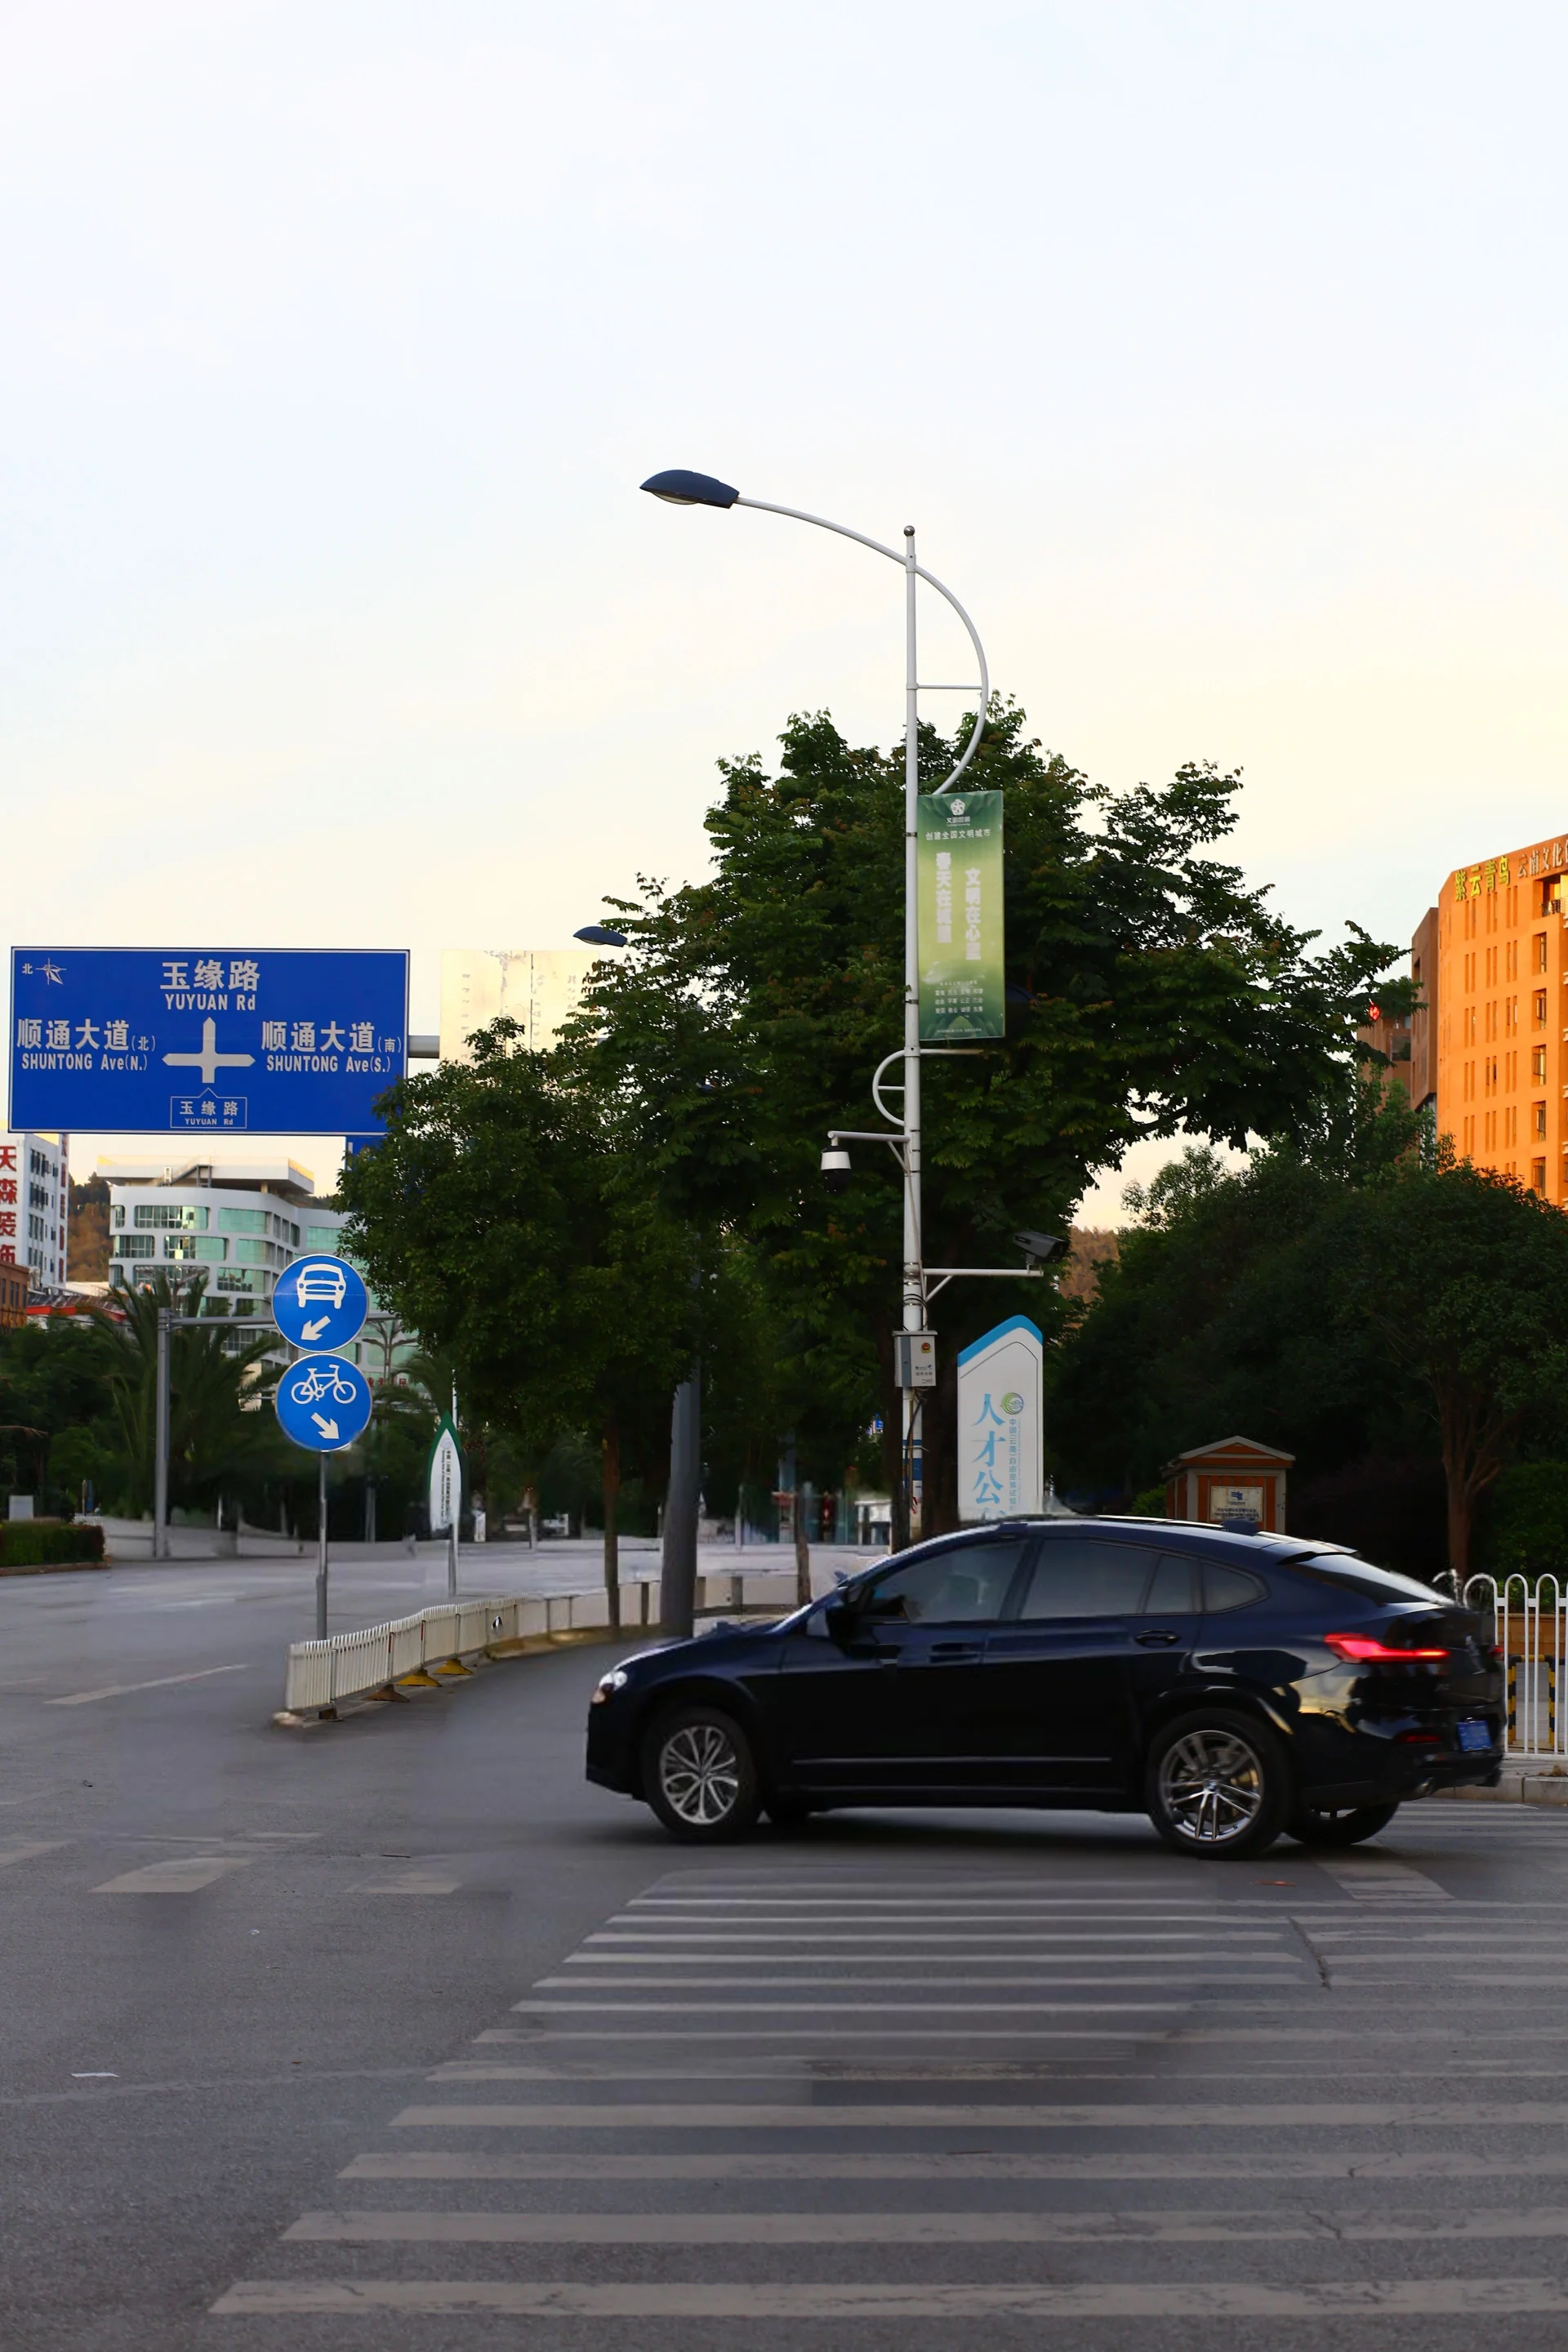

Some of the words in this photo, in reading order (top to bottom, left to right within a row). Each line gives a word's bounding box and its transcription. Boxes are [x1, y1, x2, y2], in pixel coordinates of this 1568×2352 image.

[1454, 856, 1511, 902] 紫云青鸟
[22, 963, 33, 974] 北
[160, 960, 261, 991] 玉缘路
[165, 994, 228, 1011] YUYUAN
[237, 994, 256, 1011] Rd
[16, 1018, 156, 1052] 顺通大道(北)
[261, 1020, 402, 1054] 顺通大道(南)
[21, 1053, 92, 1070] SHUNTONG
[266, 1055, 338, 1072] SHUNTONG
[180, 1100, 238, 1116] 玉缘路
